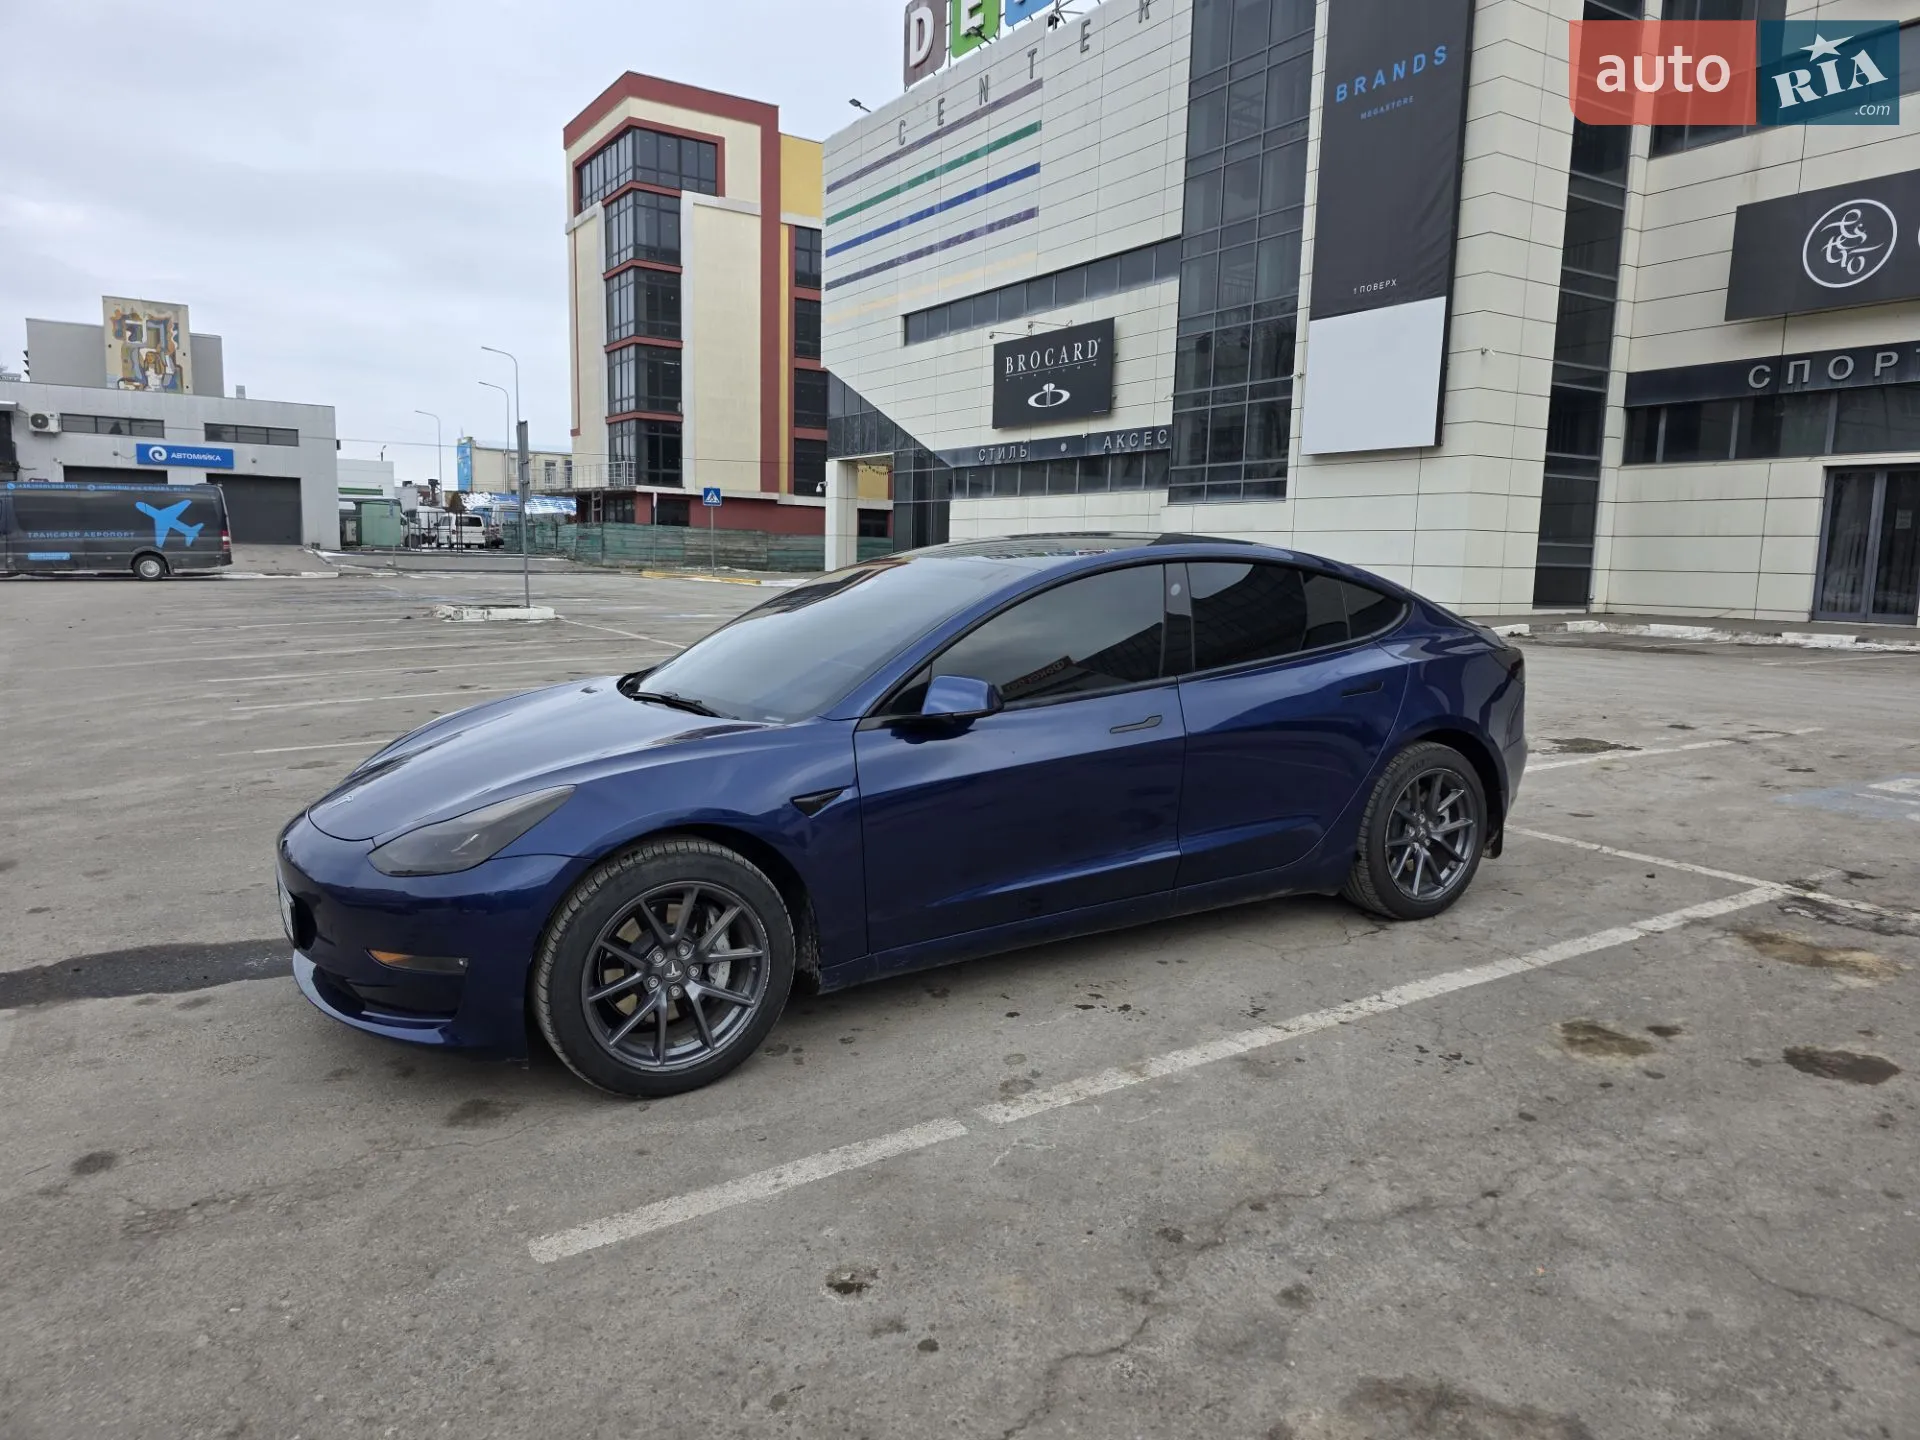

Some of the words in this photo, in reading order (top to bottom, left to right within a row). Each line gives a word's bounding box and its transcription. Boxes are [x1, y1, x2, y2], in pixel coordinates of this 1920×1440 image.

[908, 0, 1029, 67] DE
[1335, 45, 1448, 103] BRANDS
[1360, 278, 1397, 293] ПОВЕРХ
[1005, 339, 1098, 375] BROCARD
[1748, 348, 1920, 389] СПОР
[171, 452, 222, 462] АВТОМИЙКА
[978, 444, 1028, 463] СТИЛЬ
[1103, 429, 1168, 450] АКСЕС
[27, 531, 80, 539] ТРАНСФЕР
